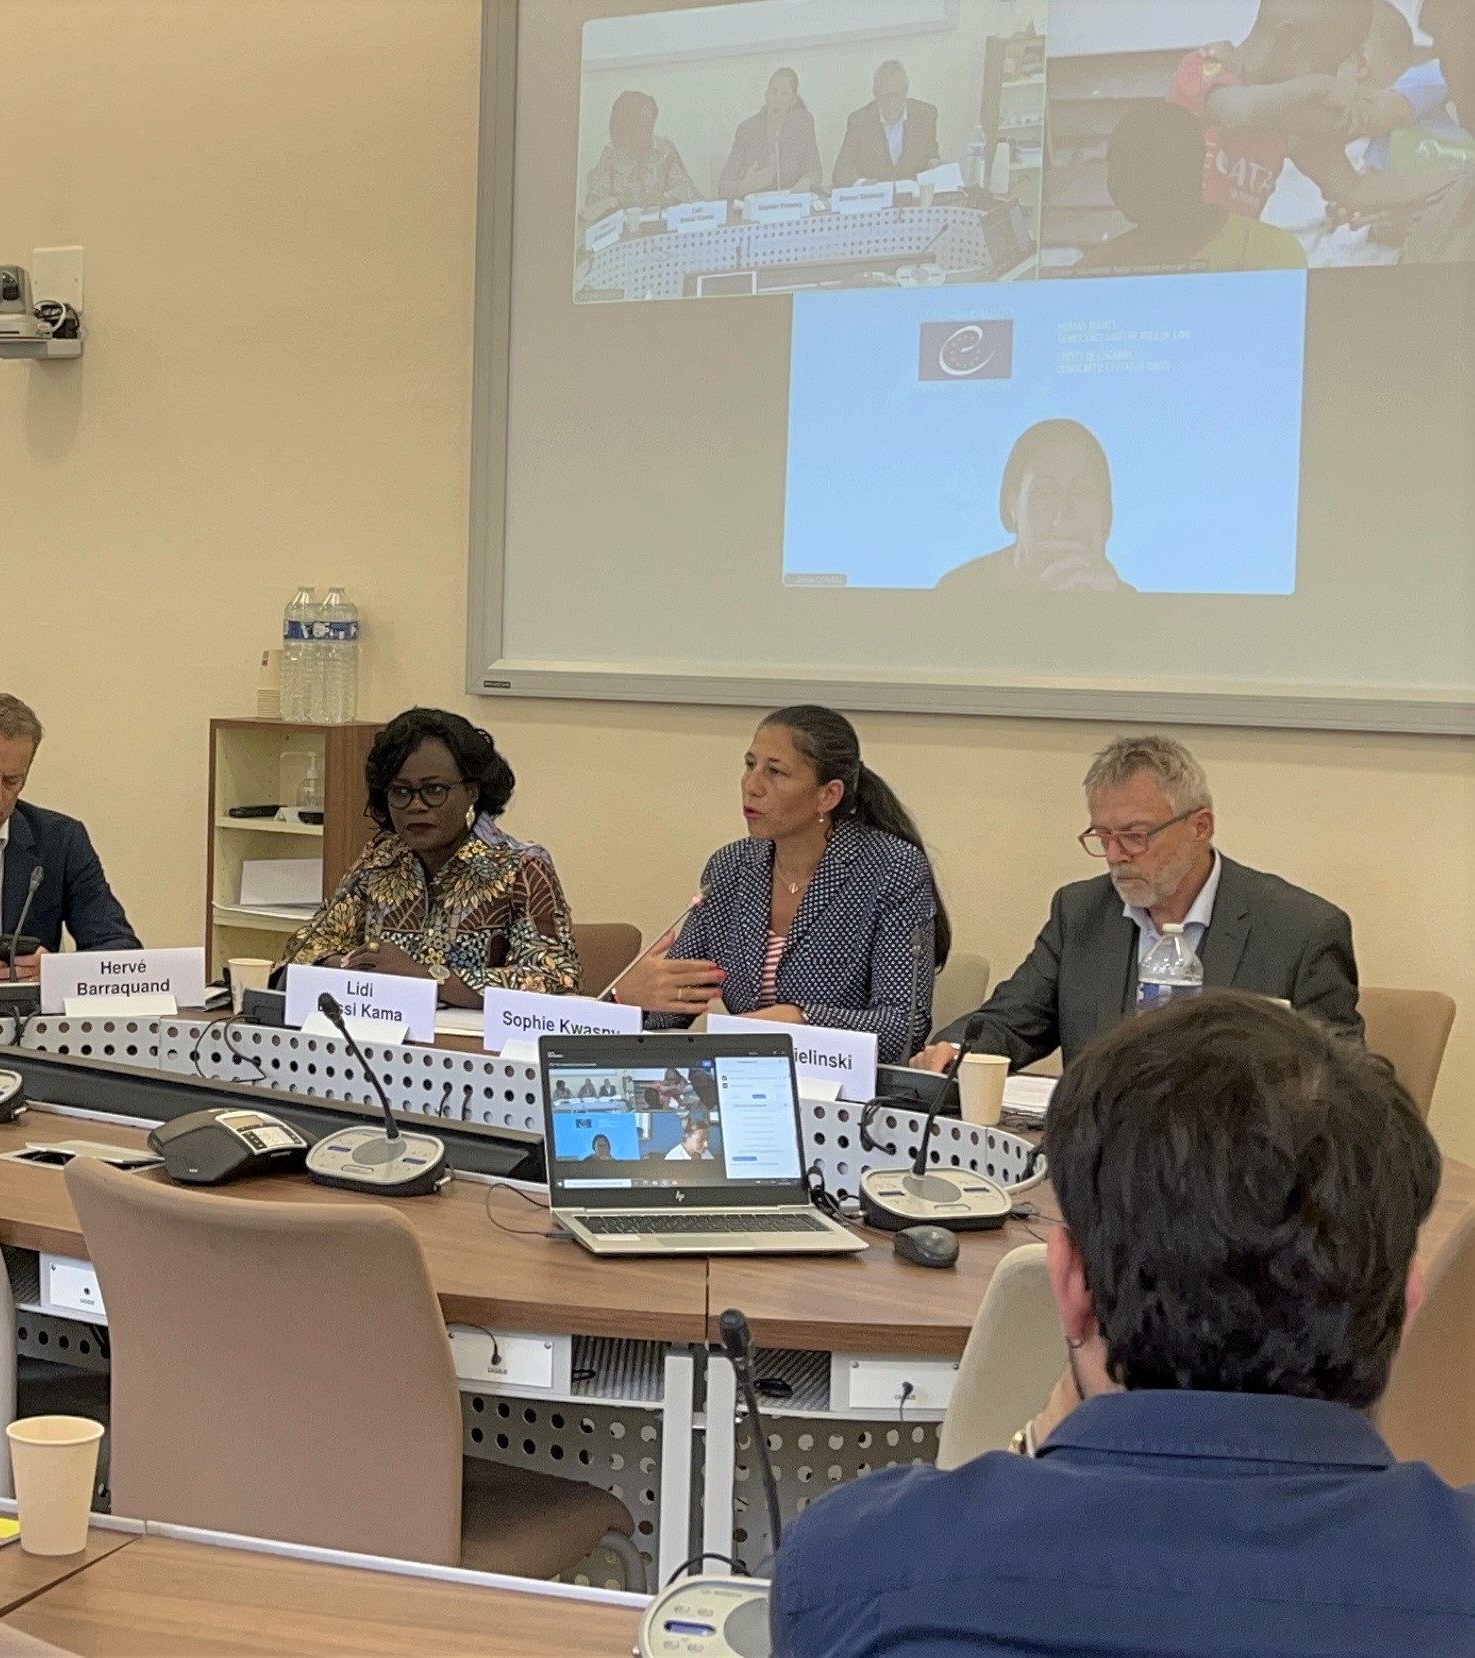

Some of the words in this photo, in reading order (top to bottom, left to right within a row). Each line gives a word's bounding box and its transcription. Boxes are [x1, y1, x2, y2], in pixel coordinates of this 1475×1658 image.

[100, 958, 147, 975] Hervé
[77, 978, 170, 997] Barraquand
[346, 980, 374, 998] Lidi
[361, 1003, 403, 1022] Kama
[502, 1010, 555, 1032] Sophie
[793, 1047, 853, 1070] ielinski
